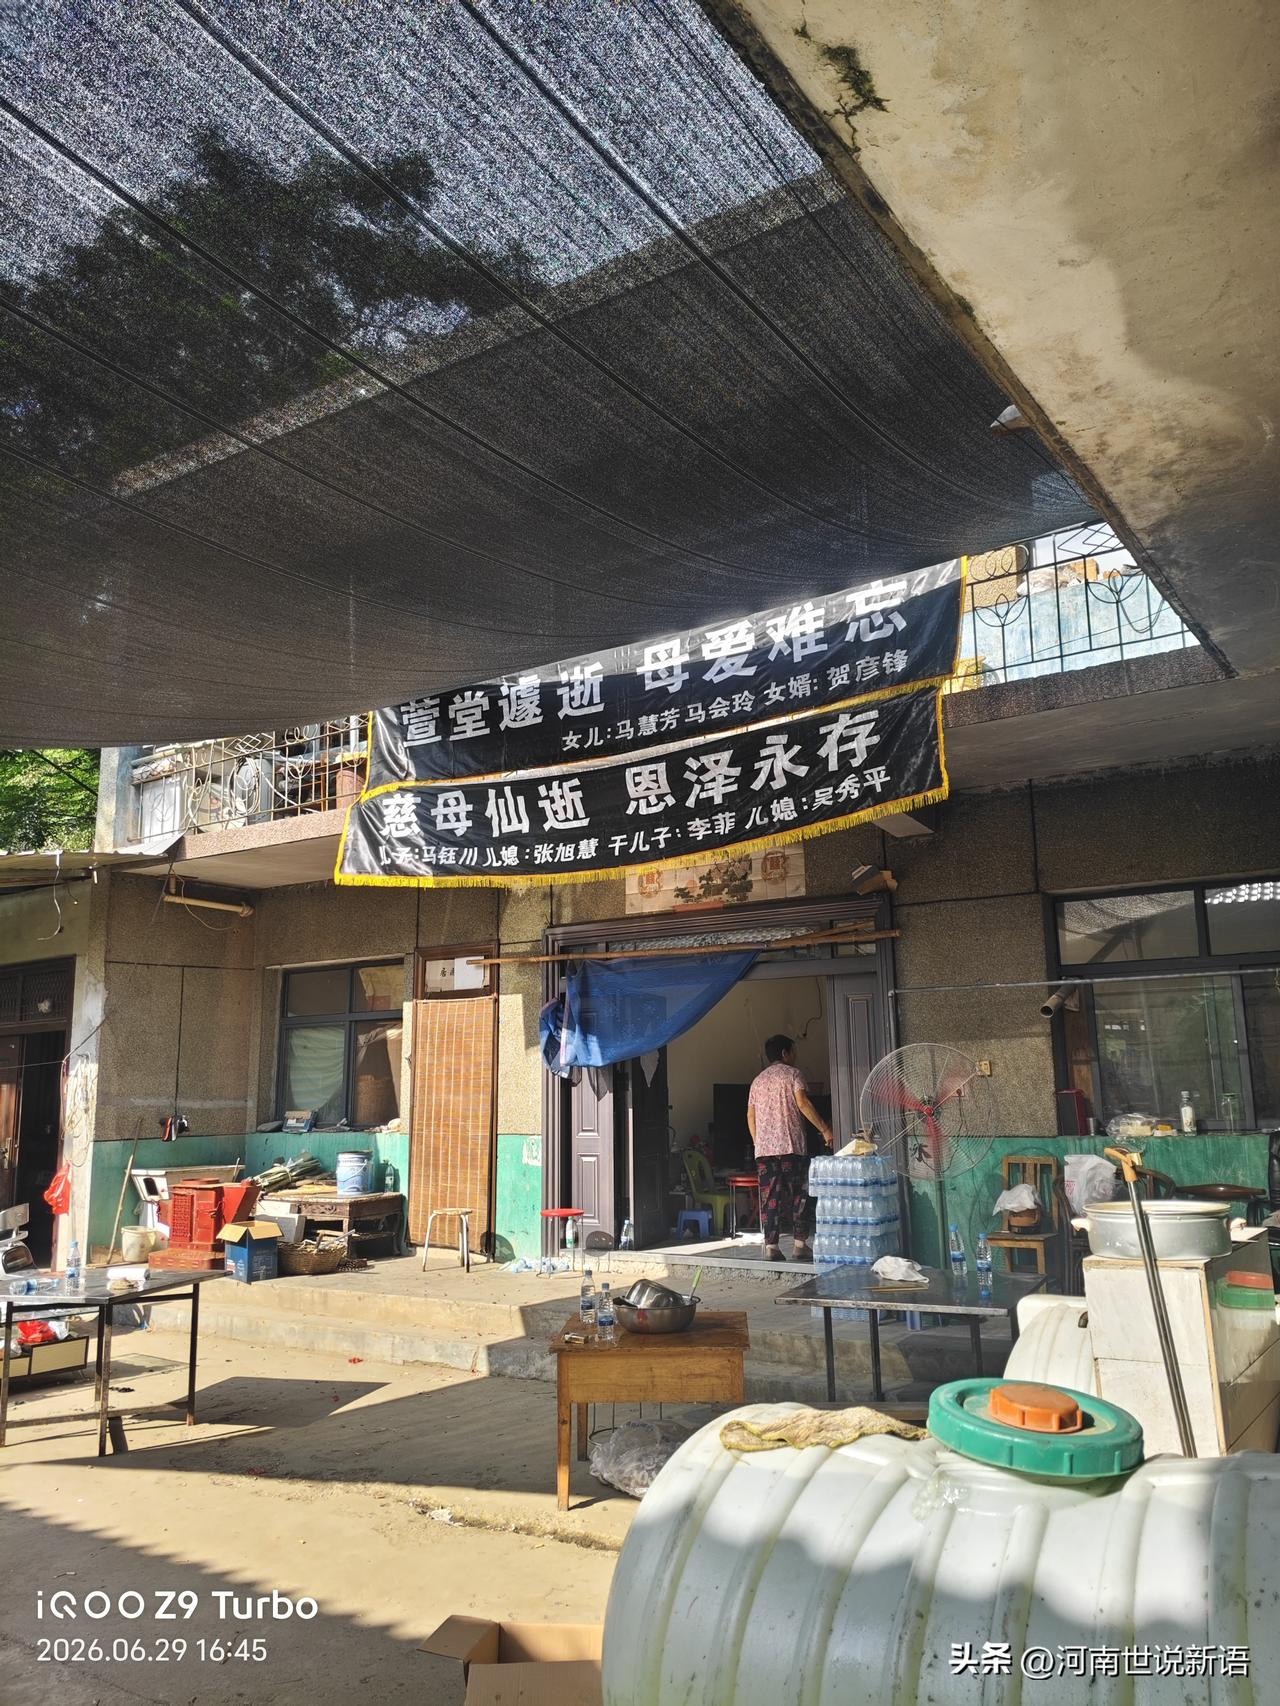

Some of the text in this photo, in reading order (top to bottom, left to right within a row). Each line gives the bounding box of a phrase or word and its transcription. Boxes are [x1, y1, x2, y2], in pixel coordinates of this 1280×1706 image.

[636, 579, 907, 694] 母爱难忘
[685, 690, 755, 723] 马会玲
[379, 709, 881, 838] 慈母仙逝 恩泽永存
